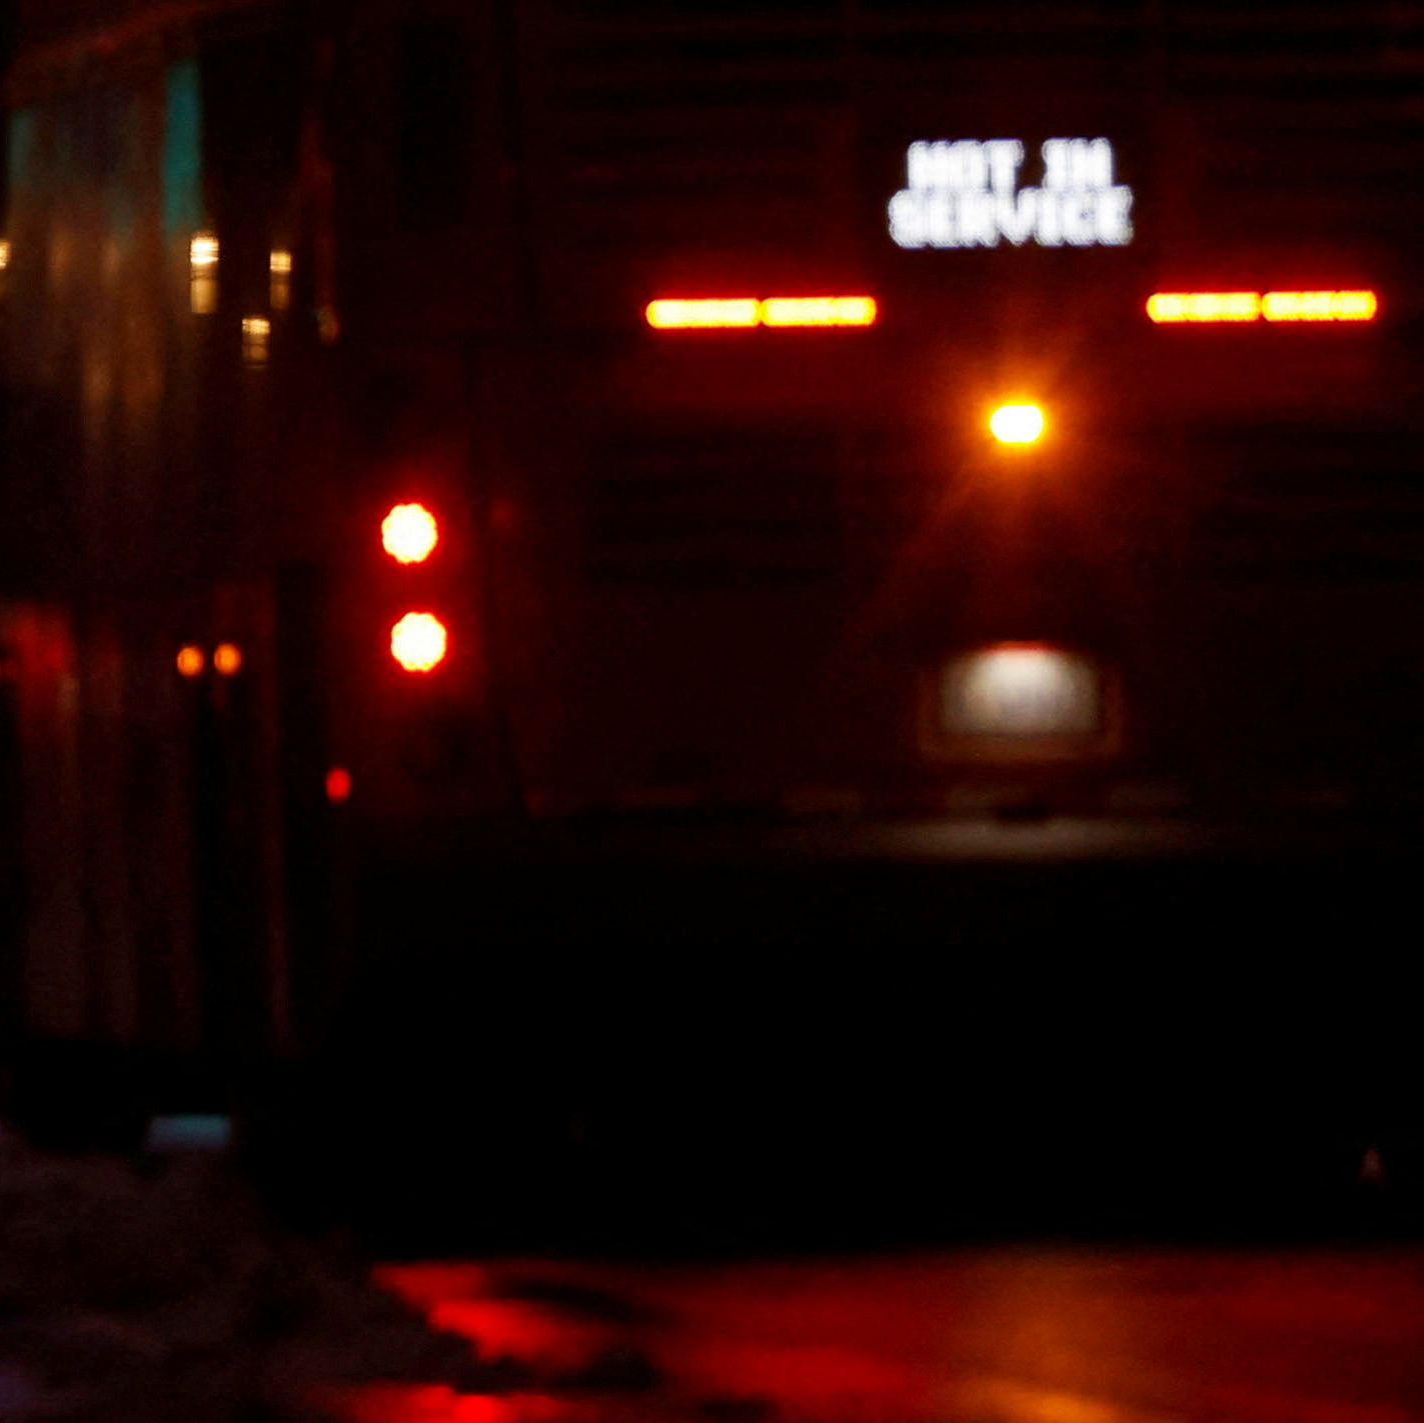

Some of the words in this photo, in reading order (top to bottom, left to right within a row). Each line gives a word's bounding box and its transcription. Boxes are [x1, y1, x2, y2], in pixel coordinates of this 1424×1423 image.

[906, 138, 1025, 188] NOT
[1041, 137, 1114, 187] IN
[888, 187, 1134, 249] SERVICE
